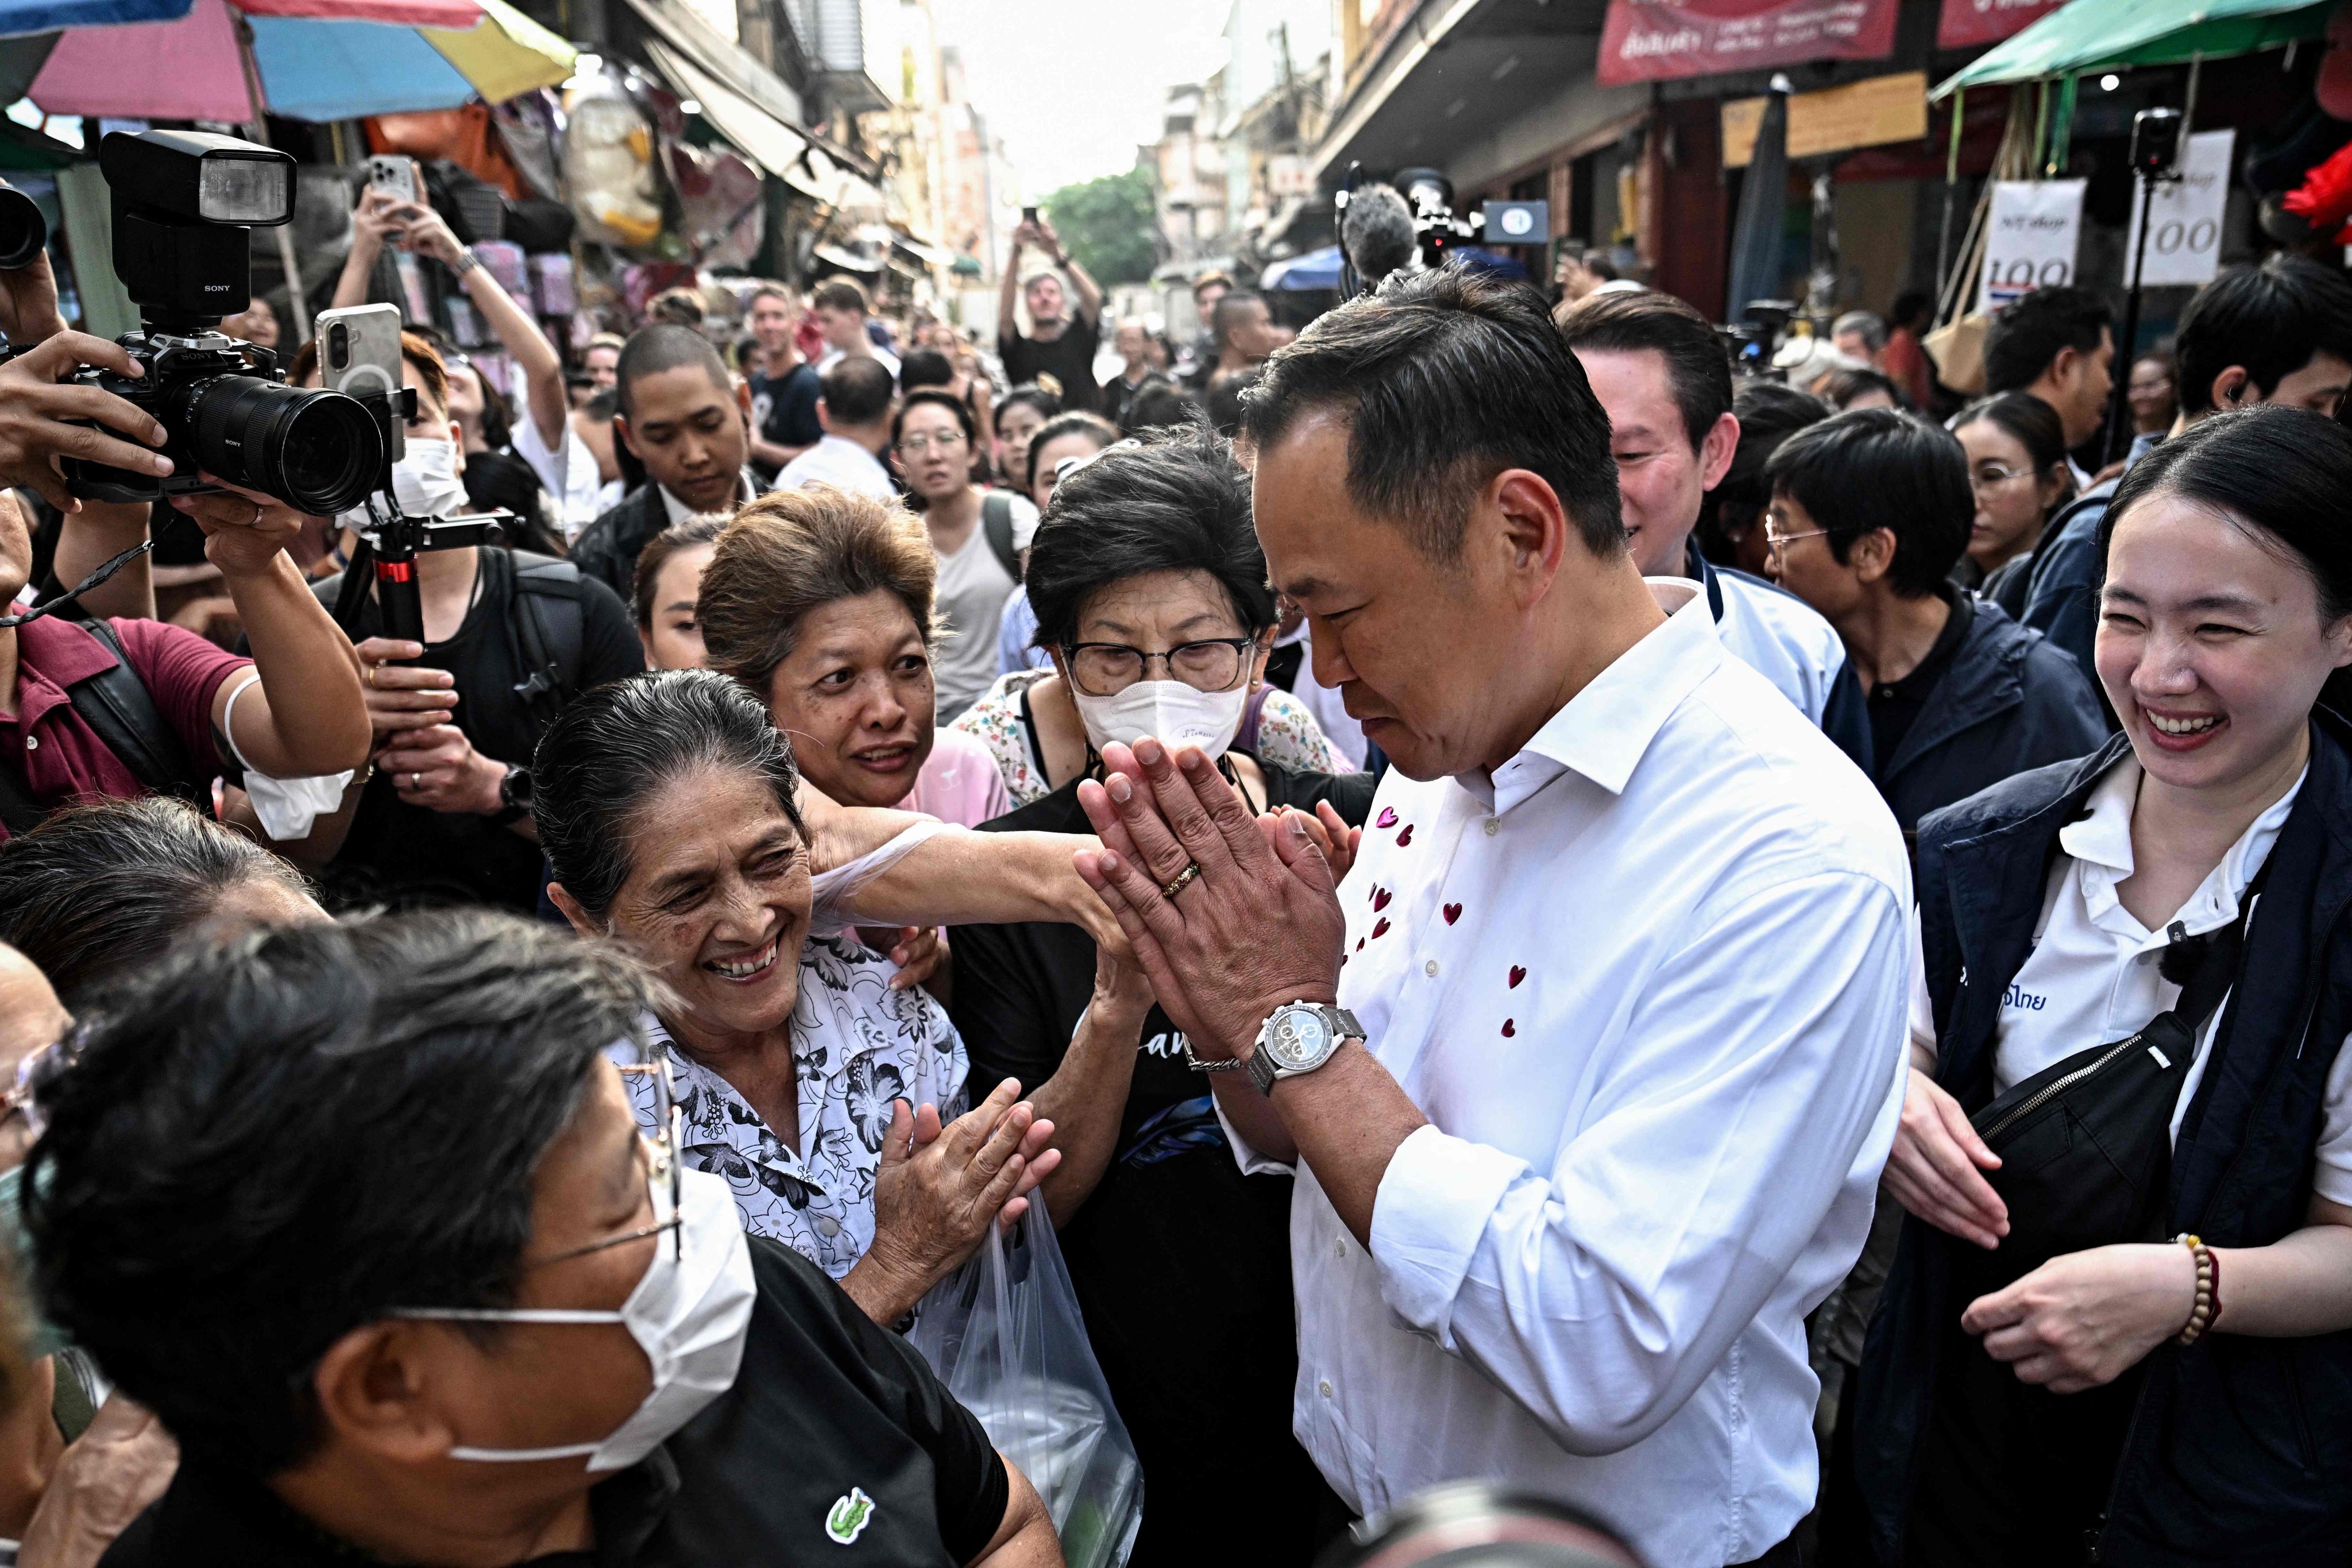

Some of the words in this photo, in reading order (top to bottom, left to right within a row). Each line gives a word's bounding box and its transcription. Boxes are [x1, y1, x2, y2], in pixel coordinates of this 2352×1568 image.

[2156, 218, 2216, 255] 00
[1990, 259, 2068, 287] 100
[181, 352, 212, 360] SONY
[225, 439, 241, 447] SONY
